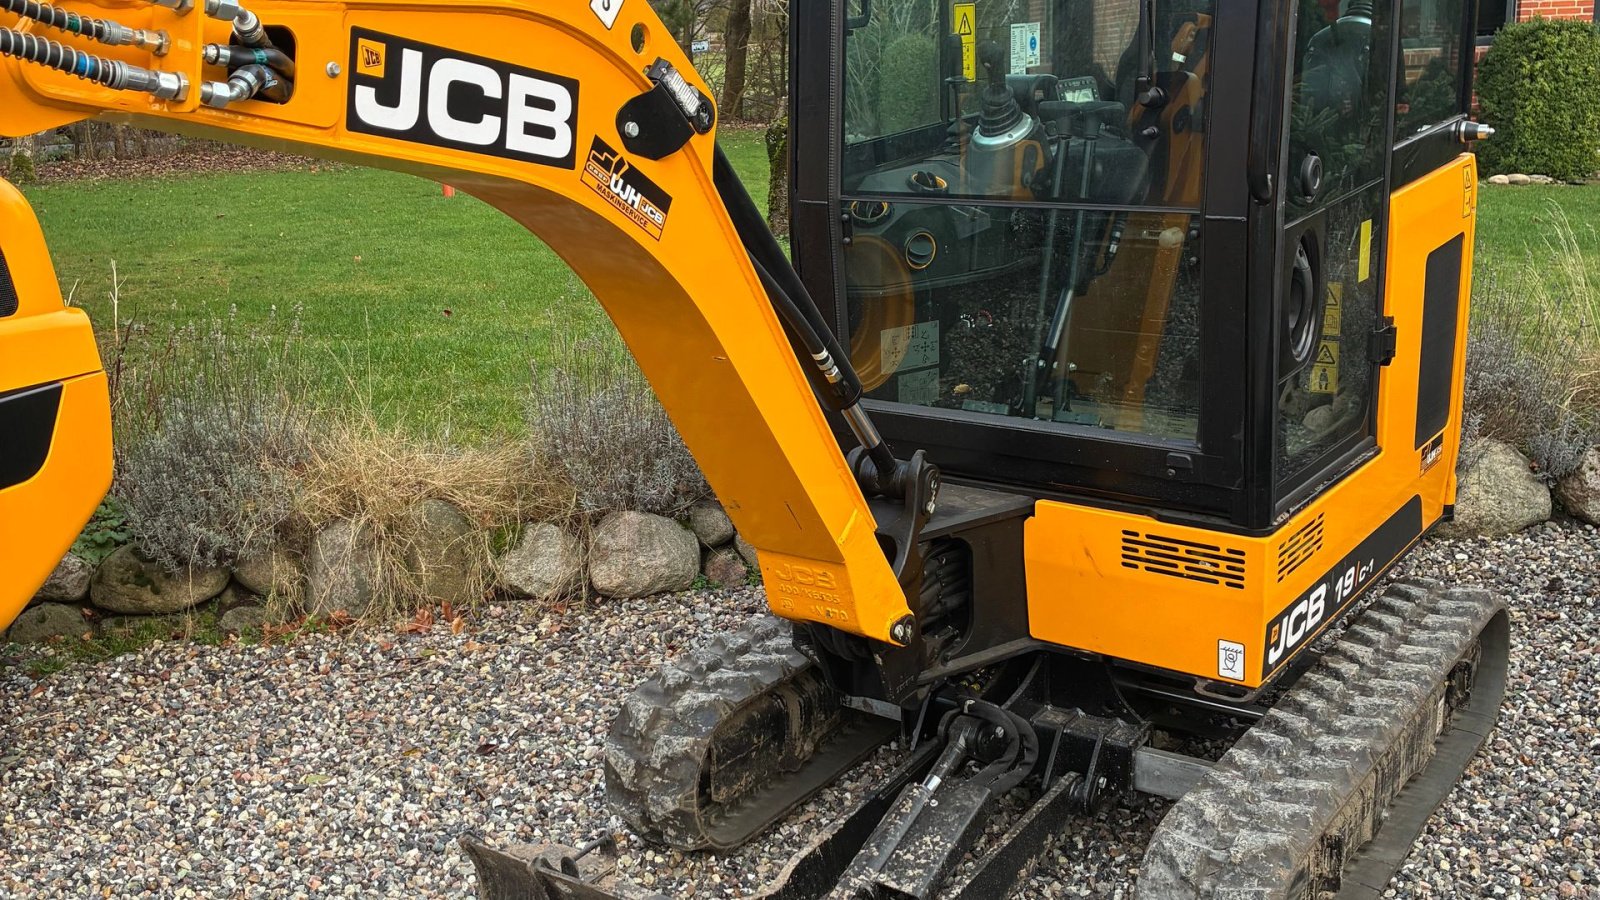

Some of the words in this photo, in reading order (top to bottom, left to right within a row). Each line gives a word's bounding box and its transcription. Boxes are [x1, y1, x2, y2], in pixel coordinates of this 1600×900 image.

[365, 47, 381, 66] JCB
[355, 47, 572, 159] JCB
[596, 183, 649, 228] MASKINSERVICE
[641, 201, 663, 225] JCB
[776, 563, 837, 590] JCB
[1268, 582, 1327, 665] JCB
[1335, 566, 1355, 603] 19
